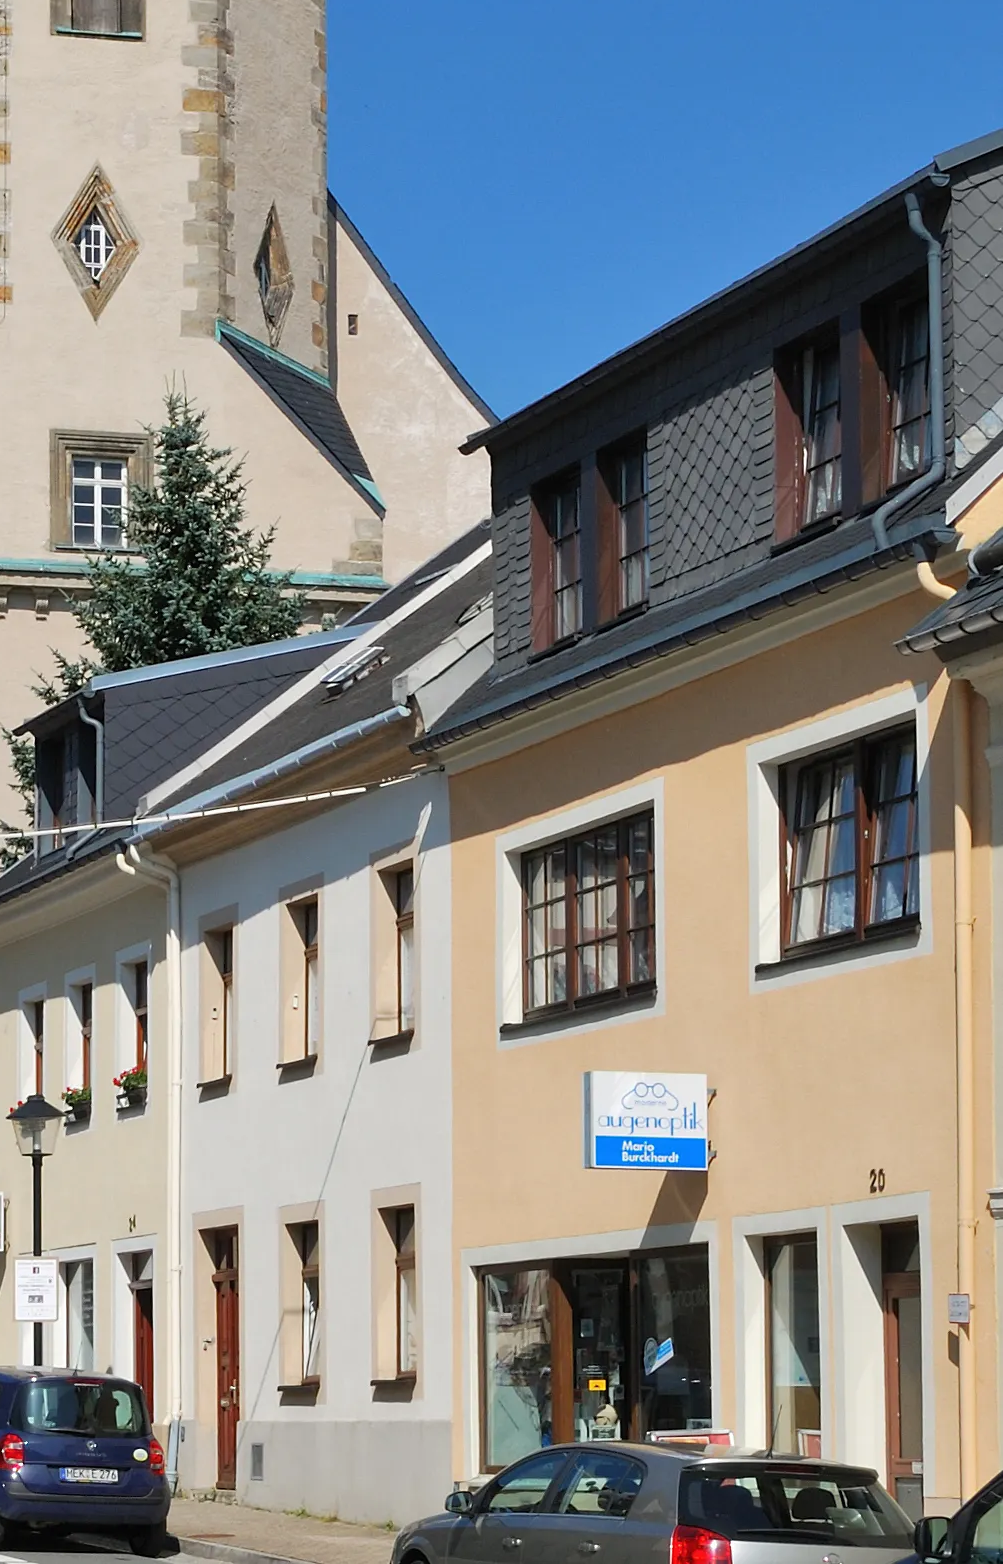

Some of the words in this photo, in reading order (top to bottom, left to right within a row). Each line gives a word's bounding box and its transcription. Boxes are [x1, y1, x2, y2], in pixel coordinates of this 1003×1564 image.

[598, 1102, 704, 1136] augenoptik
[622, 1141, 655, 1152] Mario
[622, 1151, 680, 1163] Burckhardt
[869, 1168, 885, 1193] 20
[66, 1468, 87, 1479] MEK
[91, 1469, 98, 1479] E
[100, 1469, 117, 1480] 276
